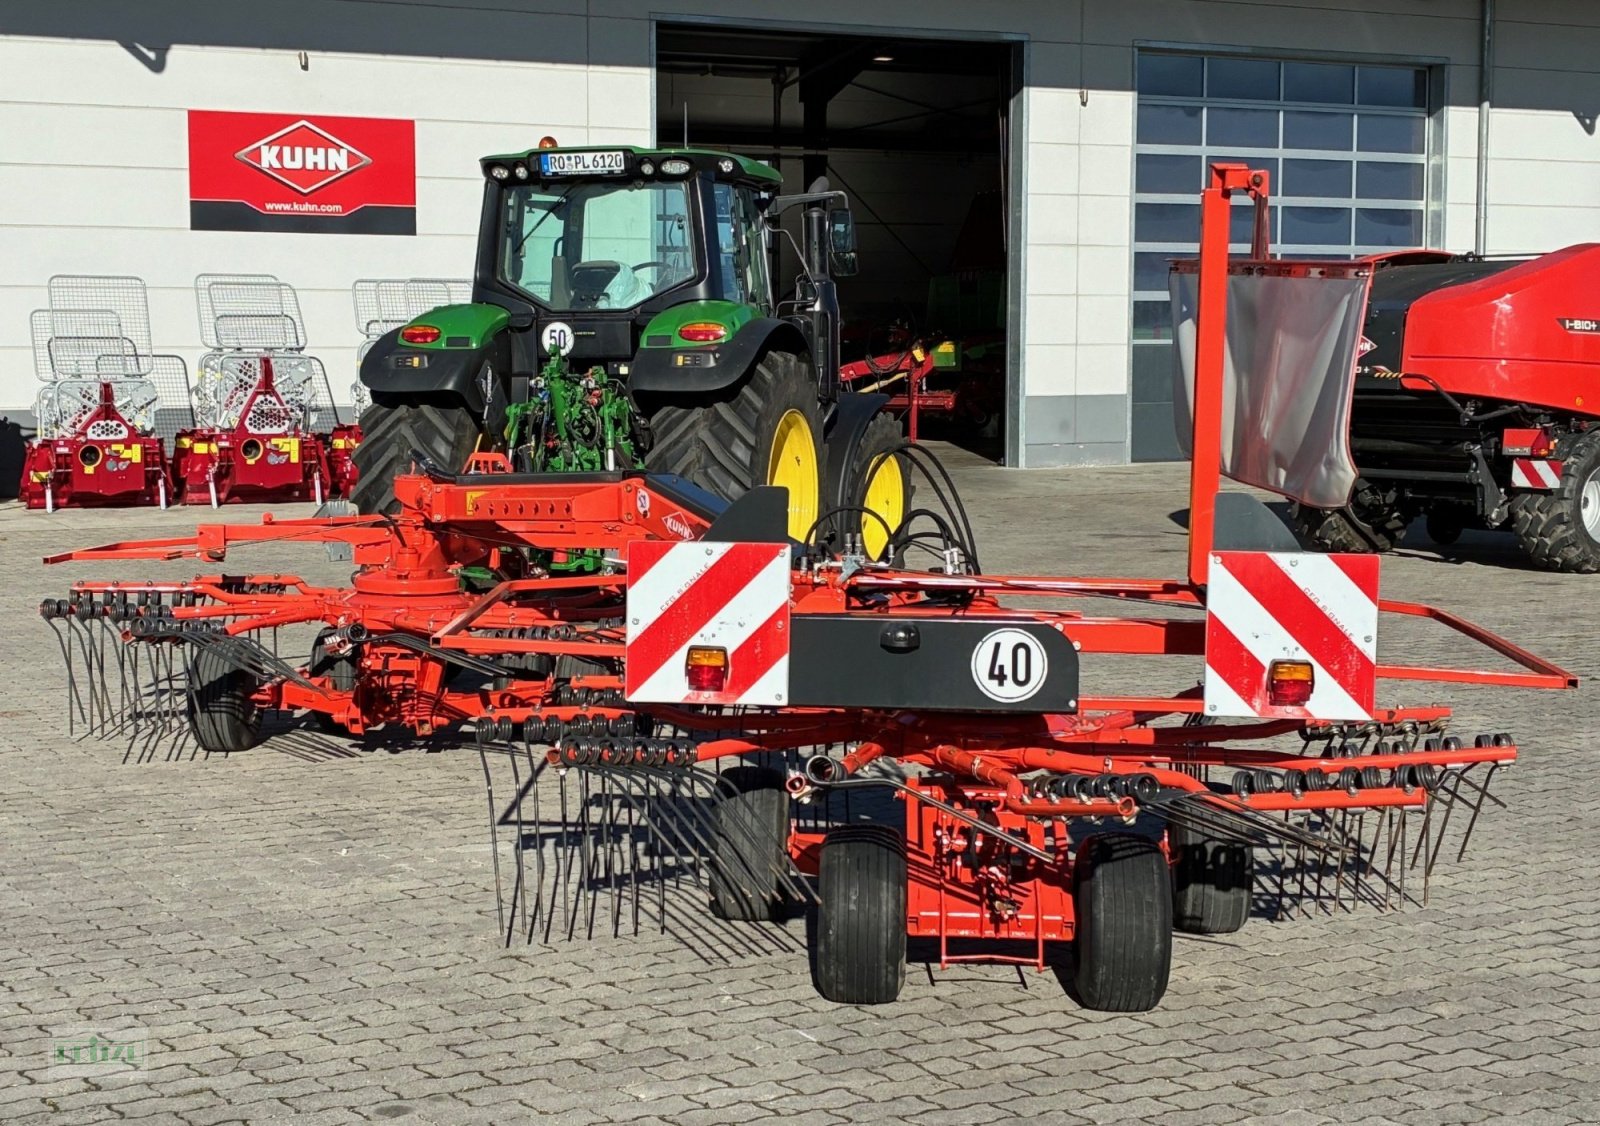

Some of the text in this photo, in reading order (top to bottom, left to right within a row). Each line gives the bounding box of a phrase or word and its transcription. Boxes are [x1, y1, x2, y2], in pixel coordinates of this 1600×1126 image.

[260, 145, 348, 171] KUHN
[550, 153, 622, 170] RO PL 6120
[265, 202, 343, 213] www.kuhn.com
[549, 329, 567, 350] 50
[666, 516, 690, 539] KUHN
[988, 642, 1031, 687] 40
